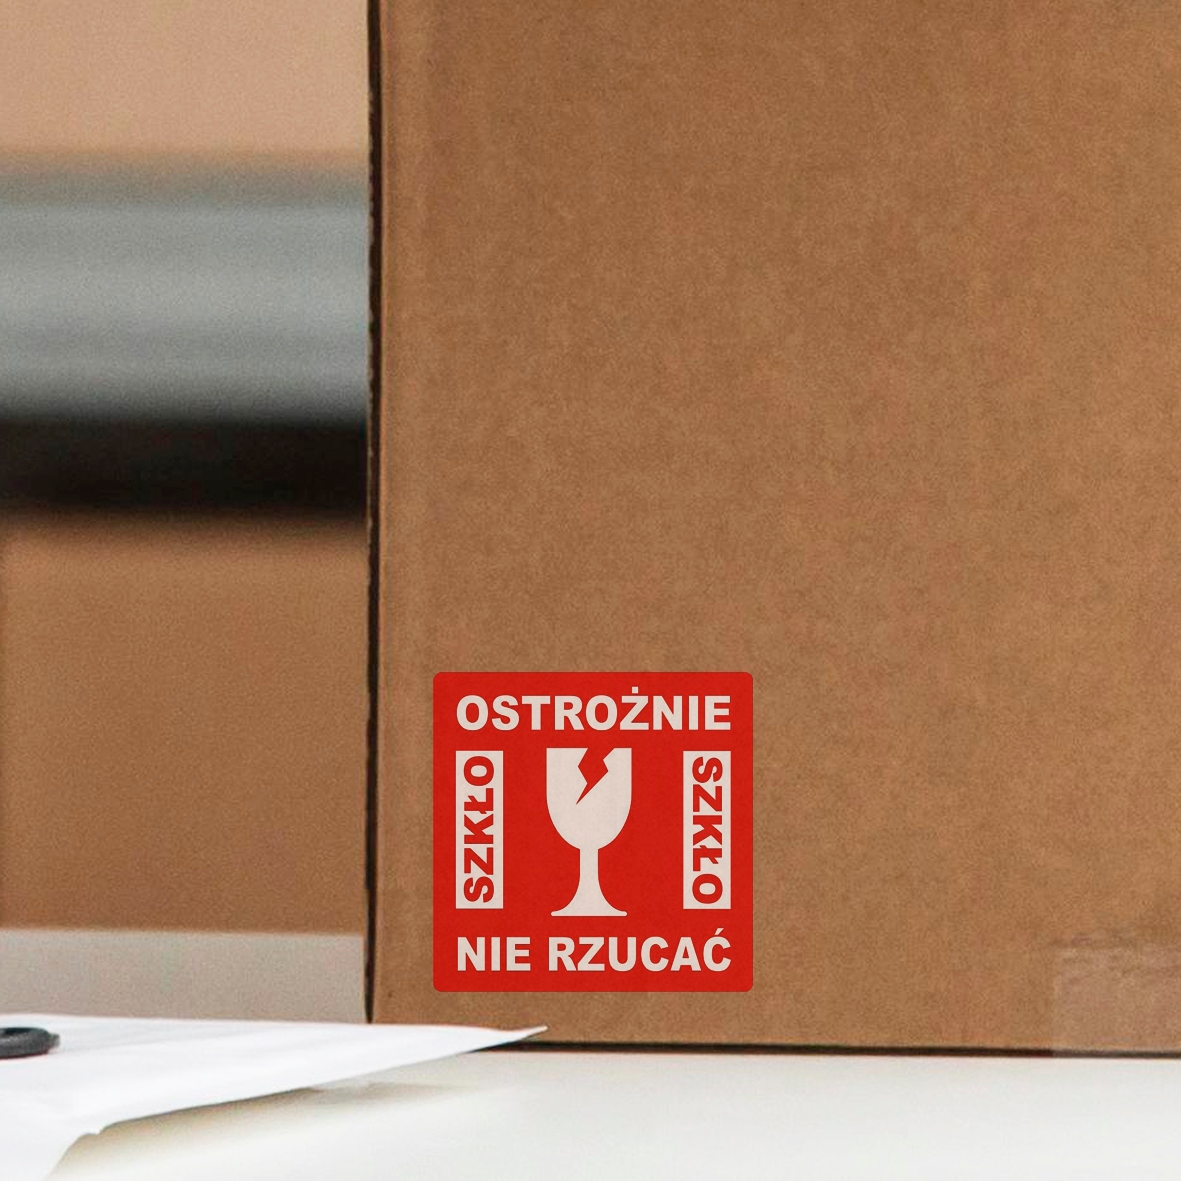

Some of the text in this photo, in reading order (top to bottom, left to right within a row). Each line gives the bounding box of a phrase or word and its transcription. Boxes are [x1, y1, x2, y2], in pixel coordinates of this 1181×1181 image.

[457, 686, 731, 731] OSTROŻNIE
[463, 755, 495, 904] SZKŁO
[691, 756, 724, 905] SZKŁO
[457, 927, 732, 972] NIE RZUCAĆ
